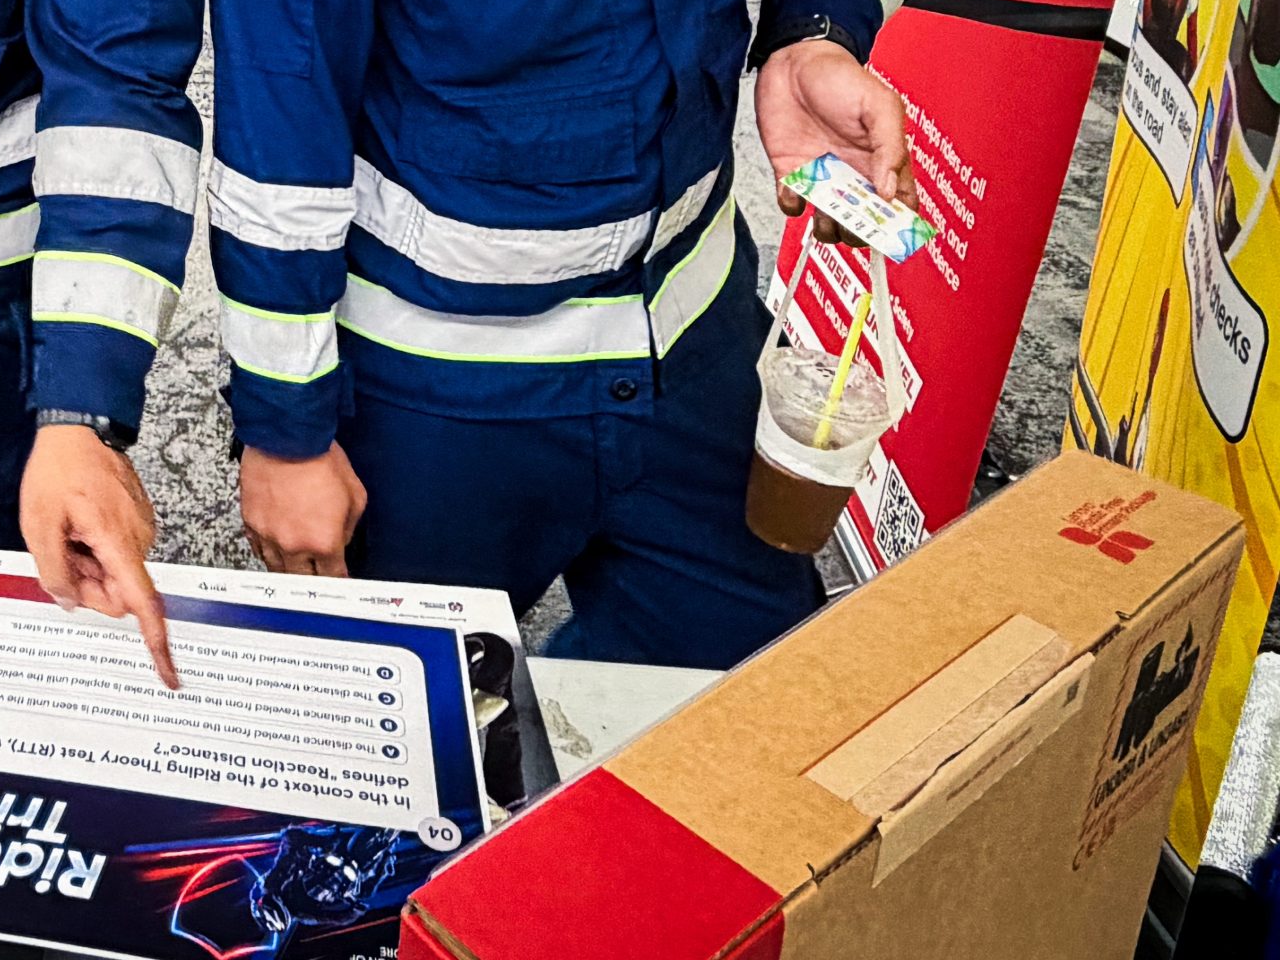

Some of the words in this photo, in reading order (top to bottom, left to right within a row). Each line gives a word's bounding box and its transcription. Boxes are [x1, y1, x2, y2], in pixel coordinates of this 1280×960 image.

[1144, 109, 1165, 145] road
[919, 109, 942, 148] helps
[940, 136, 961, 174] riders
[960, 165, 973, 186] of
[970, 176, 987, 201] all
[936, 171, 975, 230] defensive
[947, 228, 969, 261] and
[814, 242, 852, 294] HOOSE
[1209, 283, 1252, 365] checks
[20, 648, 35, 656] the
[63, 652, 87, 660] seen
[222, 650, 238, 659] the
[242, 653, 256, 662] for
[101, 657, 136, 669] hazard
[304, 661, 350, 672] distance
[207, 672, 224, 681] the
[353, 666, 371, 677] The
[27, 674, 44, 682] the
[71, 678, 110, 688] applied
[228, 675, 253, 686] from
[114, 683, 122, 692] is
[124, 685, 154, 697] brake
[256, 679, 300, 692] traveled
[303, 685, 350, 698] distance
[8, 696, 24, 704] the
[158, 689, 176, 700] the
[178, 692, 202, 704] time
[353, 690, 374, 702] The
[27, 698, 50, 707] until
[53, 701, 78, 711] seen
[205, 697, 222, 706] the
[226, 700, 252, 711] from
[82, 705, 89, 714] is
[92, 706, 130, 720] hazard
[256, 704, 300, 717] traveled
[132, 713, 150, 722] the
[154, 716, 200, 728] moment
[304, 711, 352, 724] distance
[355, 717, 375, 728] The
[203, 723, 221, 732] the
[224, 726, 251, 738] from
[254, 730, 300, 744] traveled
[8, 739, 56, 758] (RTT),
[304, 737, 353, 750] distance
[356, 743, 376, 755] The
[61, 748, 96, 763] Test
[154, 742, 246, 768] Distance"?
[101, 751, 162, 774] Theory
[167, 760, 220, 782] Riding
[252, 758, 337, 781] "Reaction
[227, 773, 255, 787] the
[260, 772, 279, 789] of
[342, 770, 410, 789] defines
[285, 779, 354, 799] context
[359, 790, 389, 806] the
[394, 794, 410, 810] In
[428, 825, 454, 842] 04
